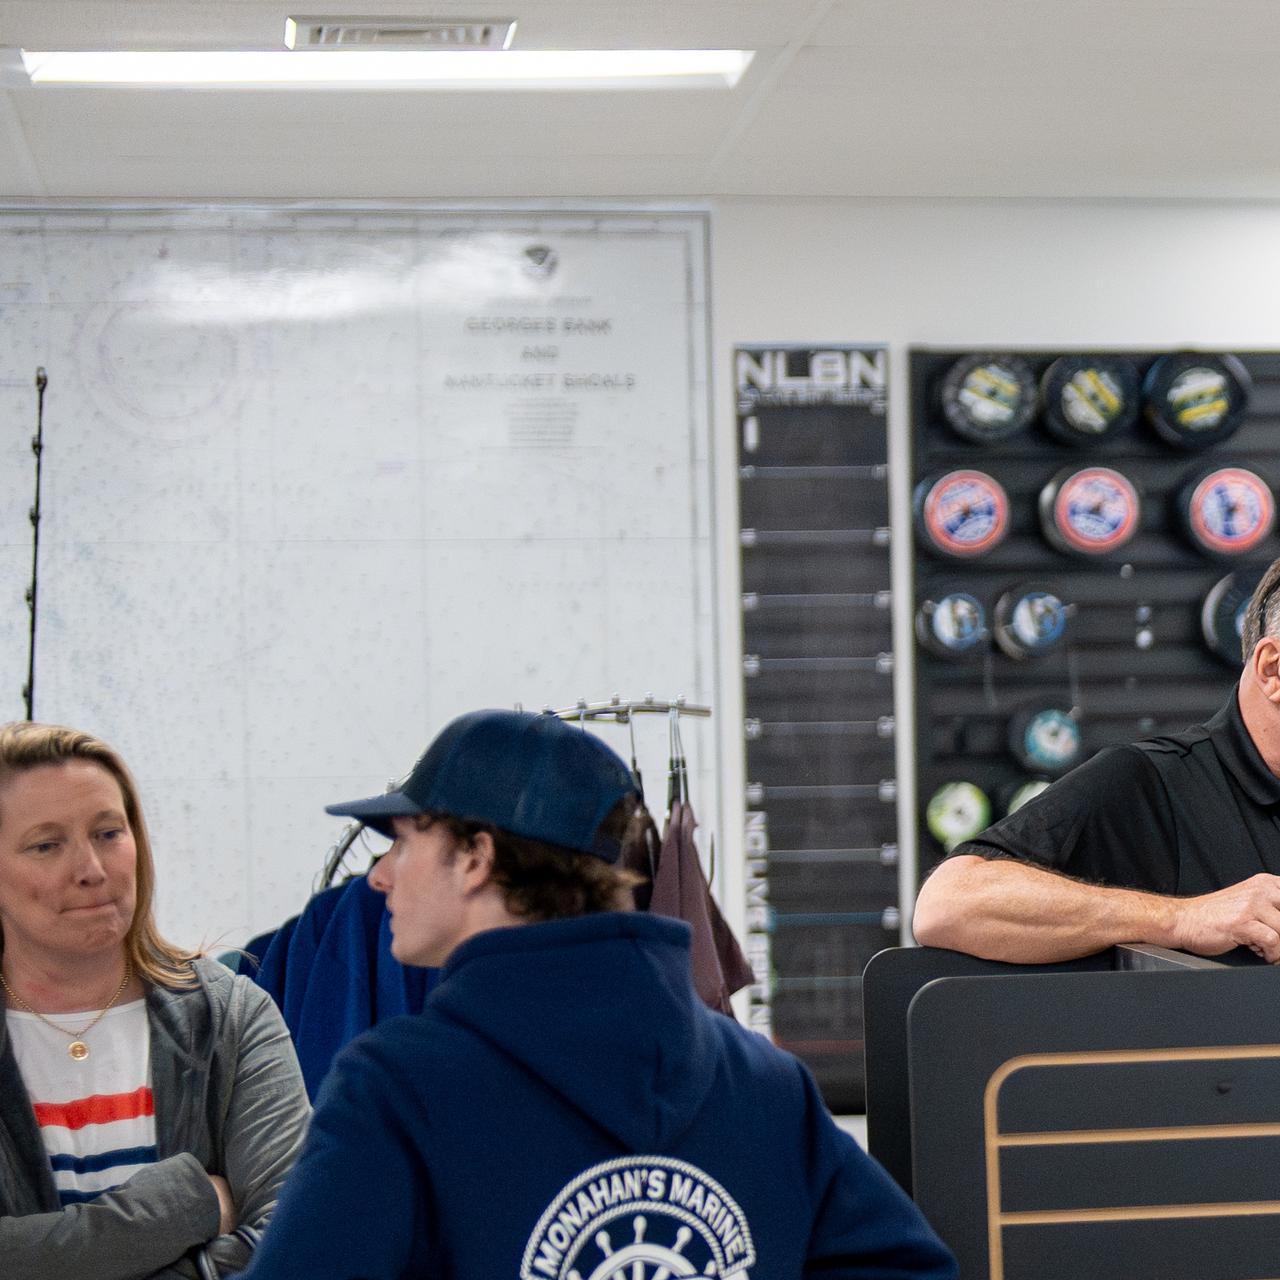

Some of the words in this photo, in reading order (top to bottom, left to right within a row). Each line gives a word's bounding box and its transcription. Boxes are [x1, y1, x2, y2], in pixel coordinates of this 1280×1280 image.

[737, 350, 886, 389] NLBN
[533, 1168, 668, 1277] MONAHAN'S
[668, 1172, 745, 1265] MARINE
